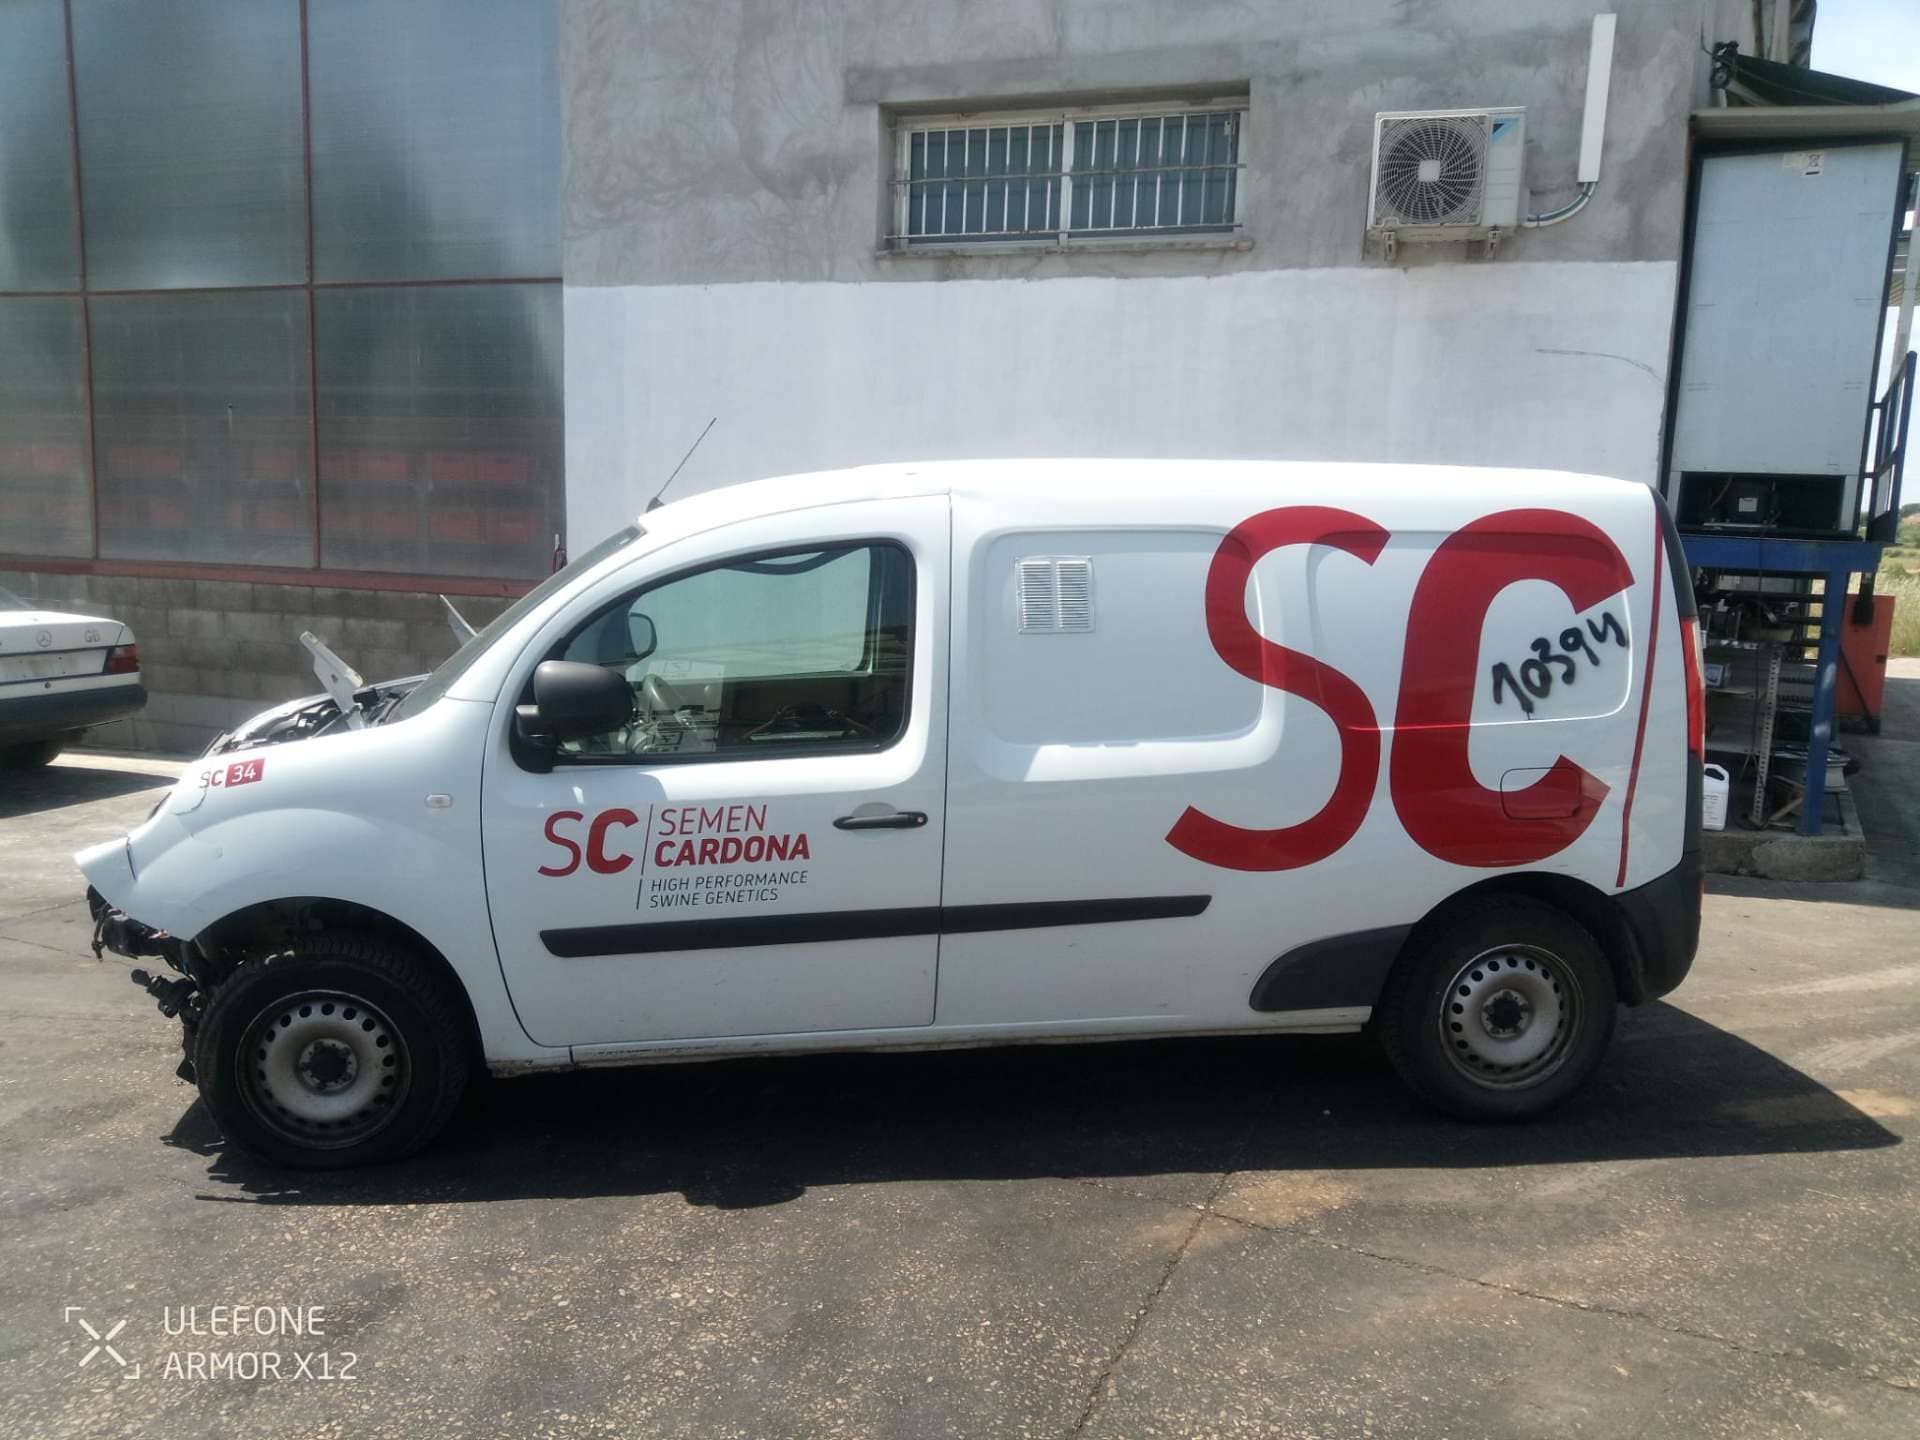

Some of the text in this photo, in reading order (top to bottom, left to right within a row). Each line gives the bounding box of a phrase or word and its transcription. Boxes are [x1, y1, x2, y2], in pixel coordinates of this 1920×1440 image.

[1492, 612, 1627, 715] 10394
[1164, 505, 1636, 873] SC
[199, 762, 257, 789] SC 34
[658, 804, 768, 836] SEMEN
[537, 808, 640, 878] SC
[654, 833, 811, 867] CARDONA
[651, 870, 809, 892] HIGH PERFORMANCE
[649, 888, 779, 909] SWINE GENETICS
